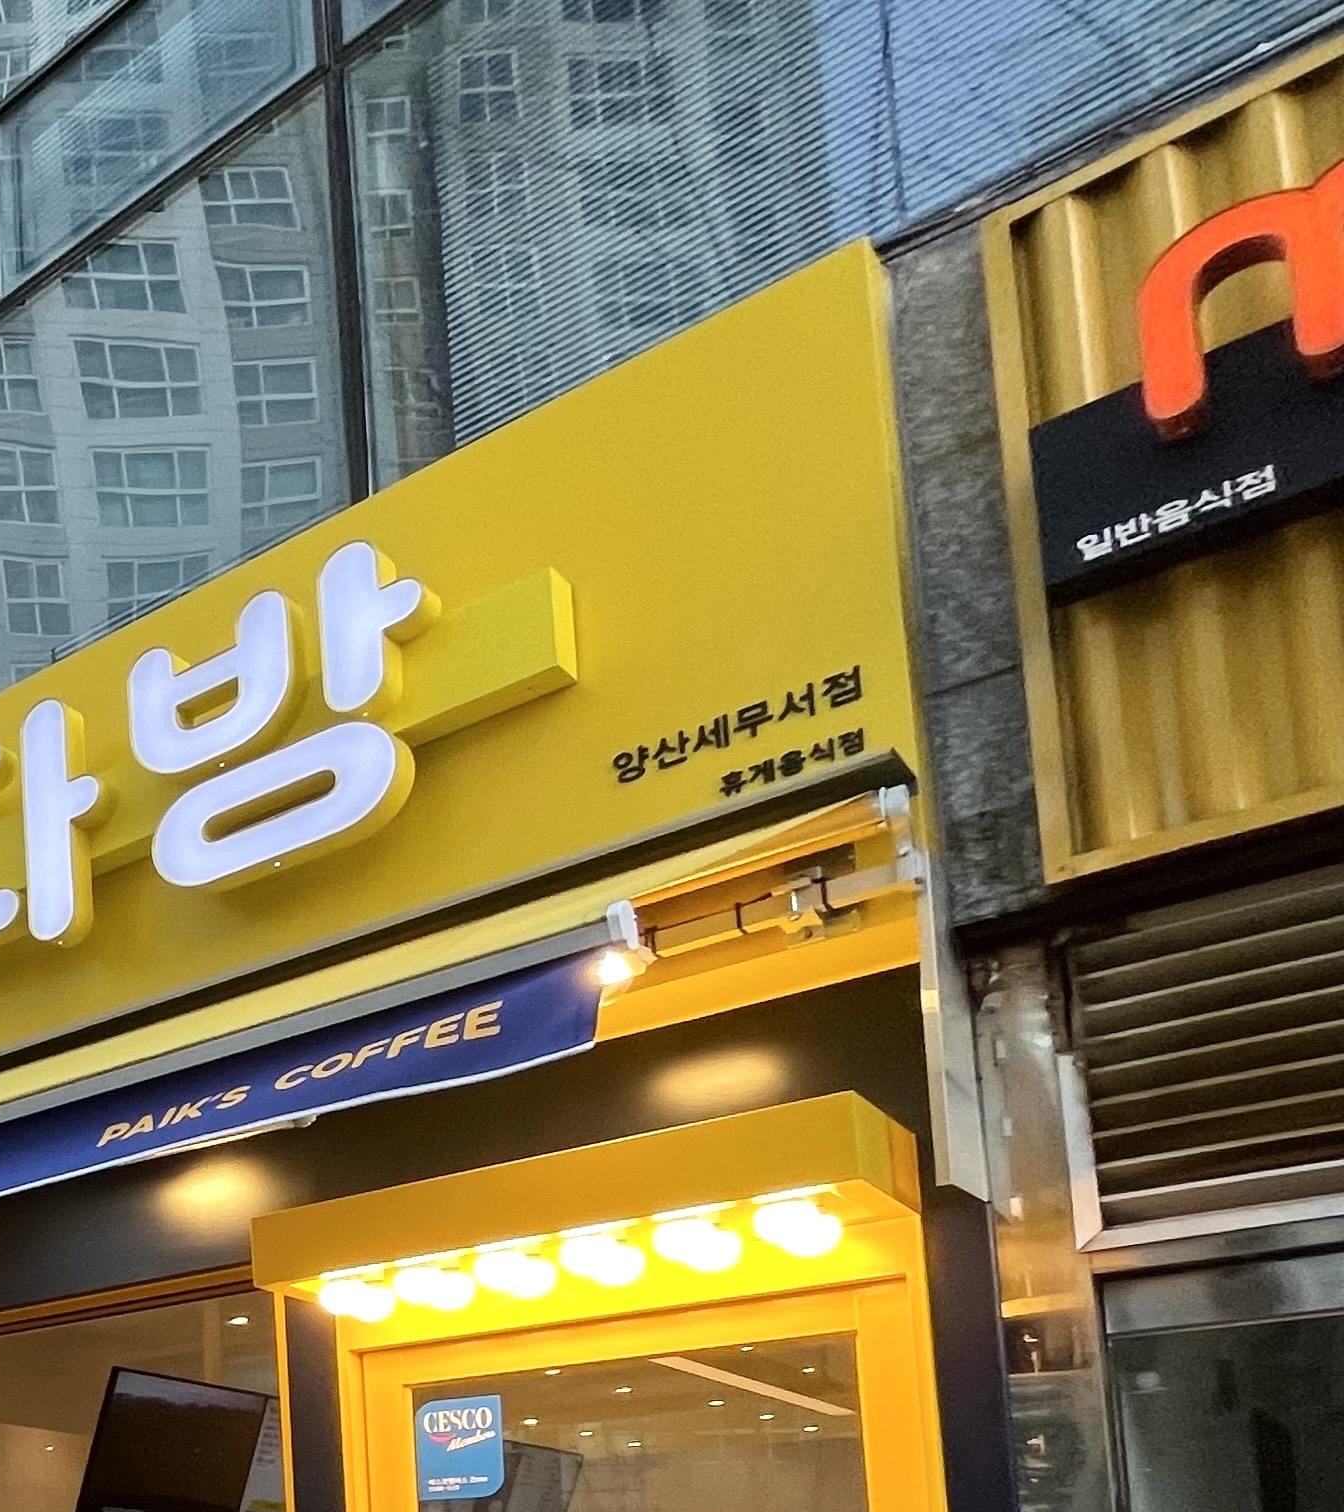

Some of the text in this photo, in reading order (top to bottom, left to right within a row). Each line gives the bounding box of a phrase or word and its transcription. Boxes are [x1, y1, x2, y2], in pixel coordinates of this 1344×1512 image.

[1076, 464, 1275, 561] 일반음식점
[613, 665, 863, 783] 양산세무서점
[719, 728, 864, 796] 휴게음식점
[96, 1000, 504, 1148] PAIK'S COFFEE
[423, 1406, 493, 1433] CESCO
